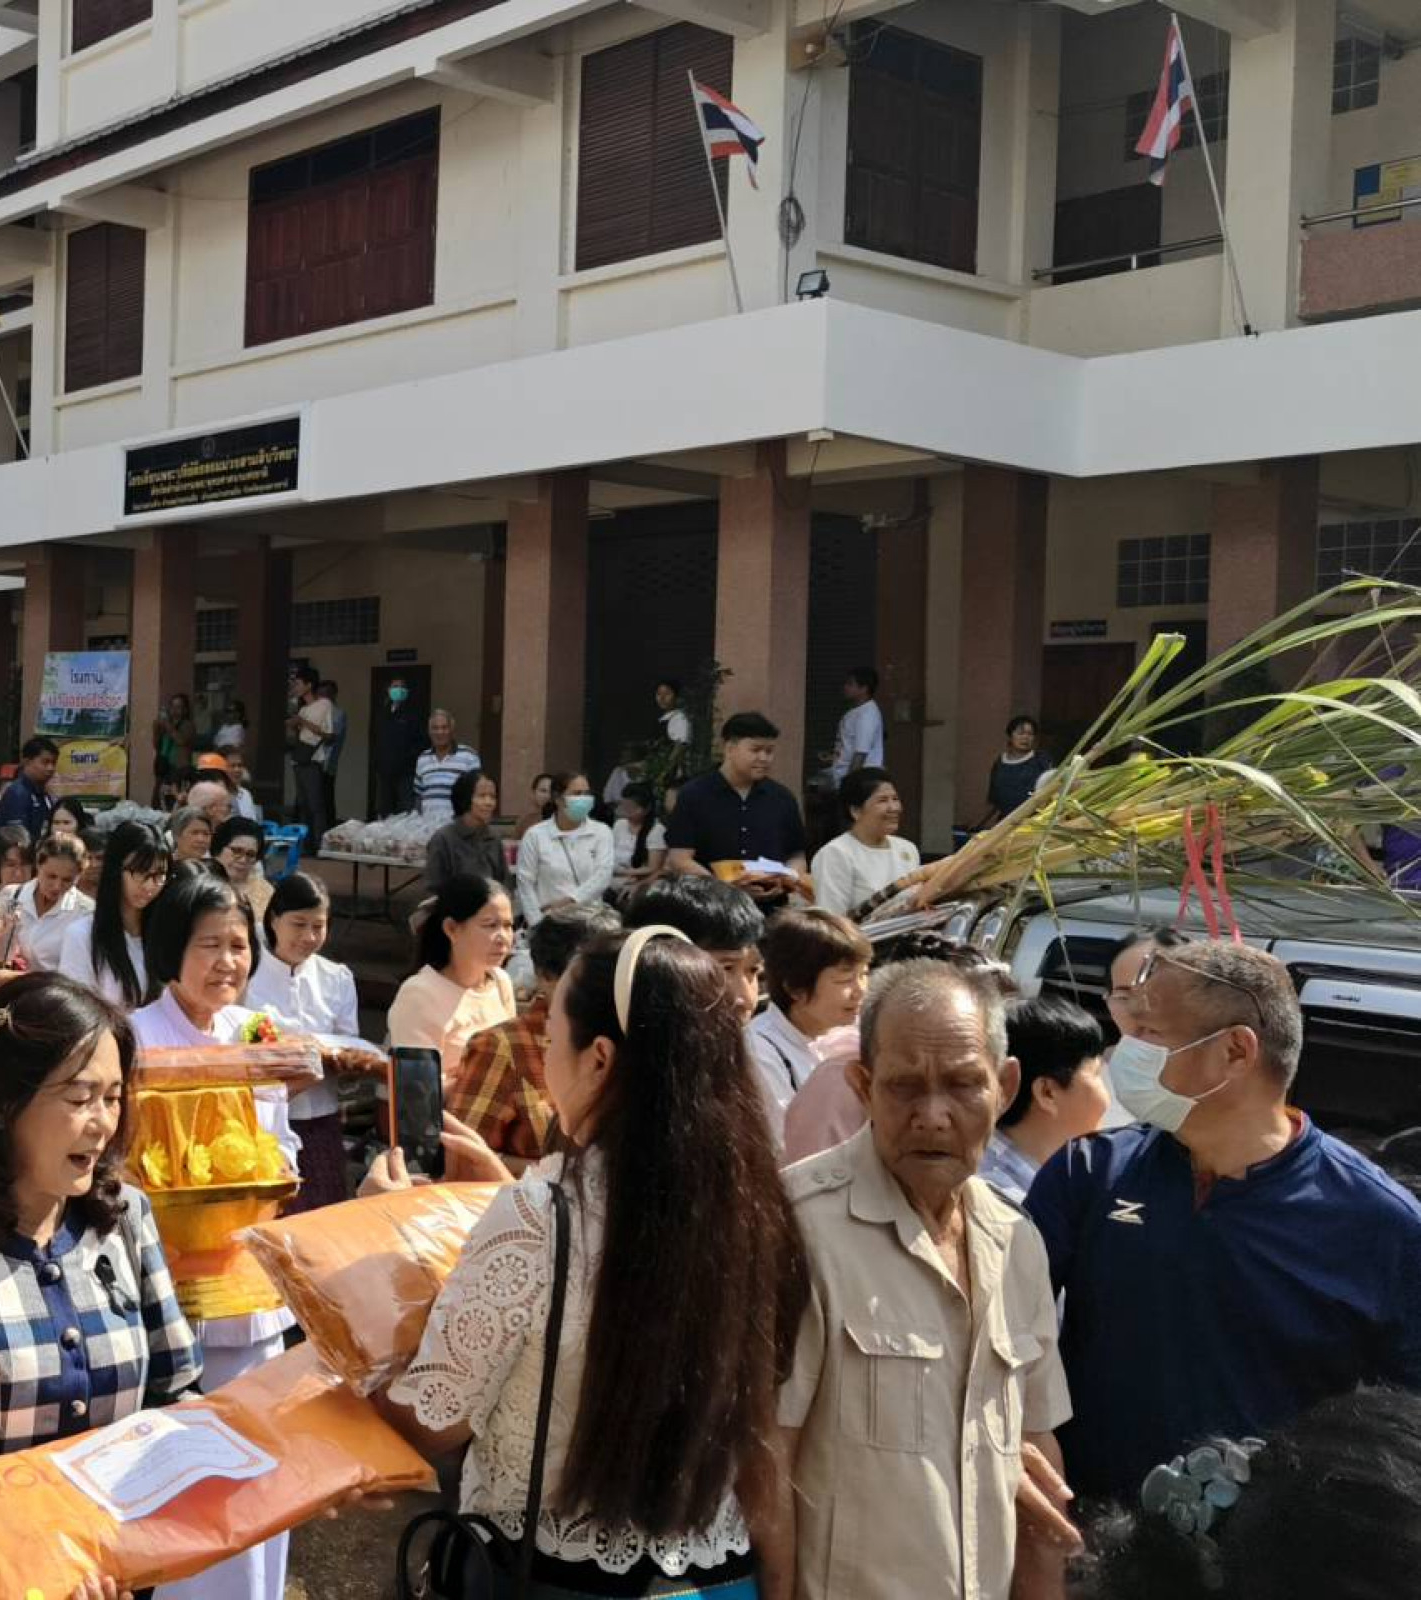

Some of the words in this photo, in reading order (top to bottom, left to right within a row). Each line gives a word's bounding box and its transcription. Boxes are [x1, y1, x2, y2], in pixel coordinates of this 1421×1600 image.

[71, 668, 104, 684] โรงทาน
[71, 749, 99, 764] โรงทาน
